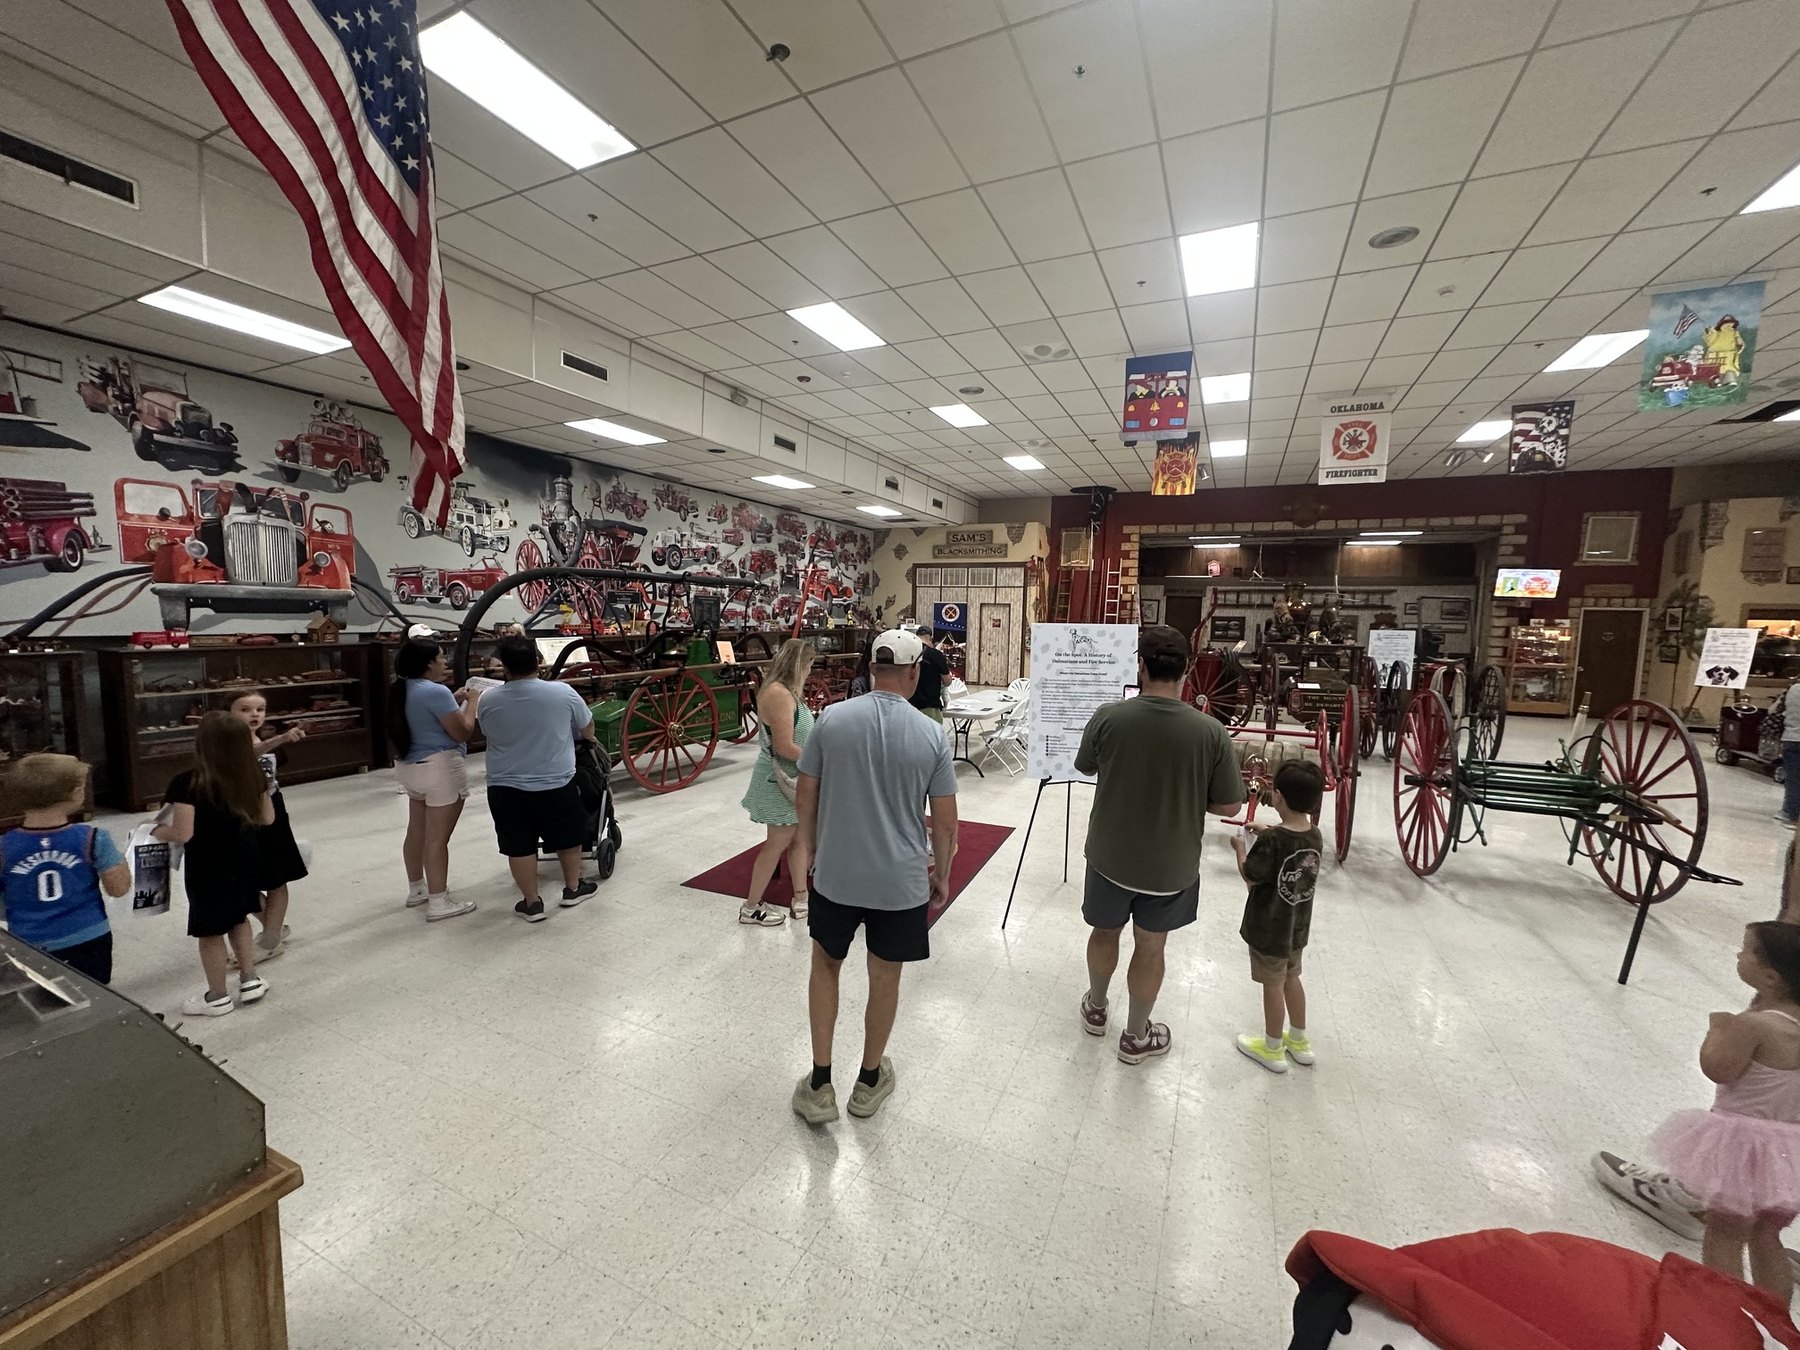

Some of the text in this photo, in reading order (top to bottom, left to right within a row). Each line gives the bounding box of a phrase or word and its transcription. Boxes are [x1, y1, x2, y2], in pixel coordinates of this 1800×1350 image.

[1330, 402, 1384, 414] OKLAHOMA
[1325, 468, 1378, 479] FIREFIGHTER
[952, 533, 986, 543] SAM'S
[1255, 708, 1284, 722] FIE
[10, 850, 82, 875] WESTBROOK
[38, 869, 63, 902] 0
